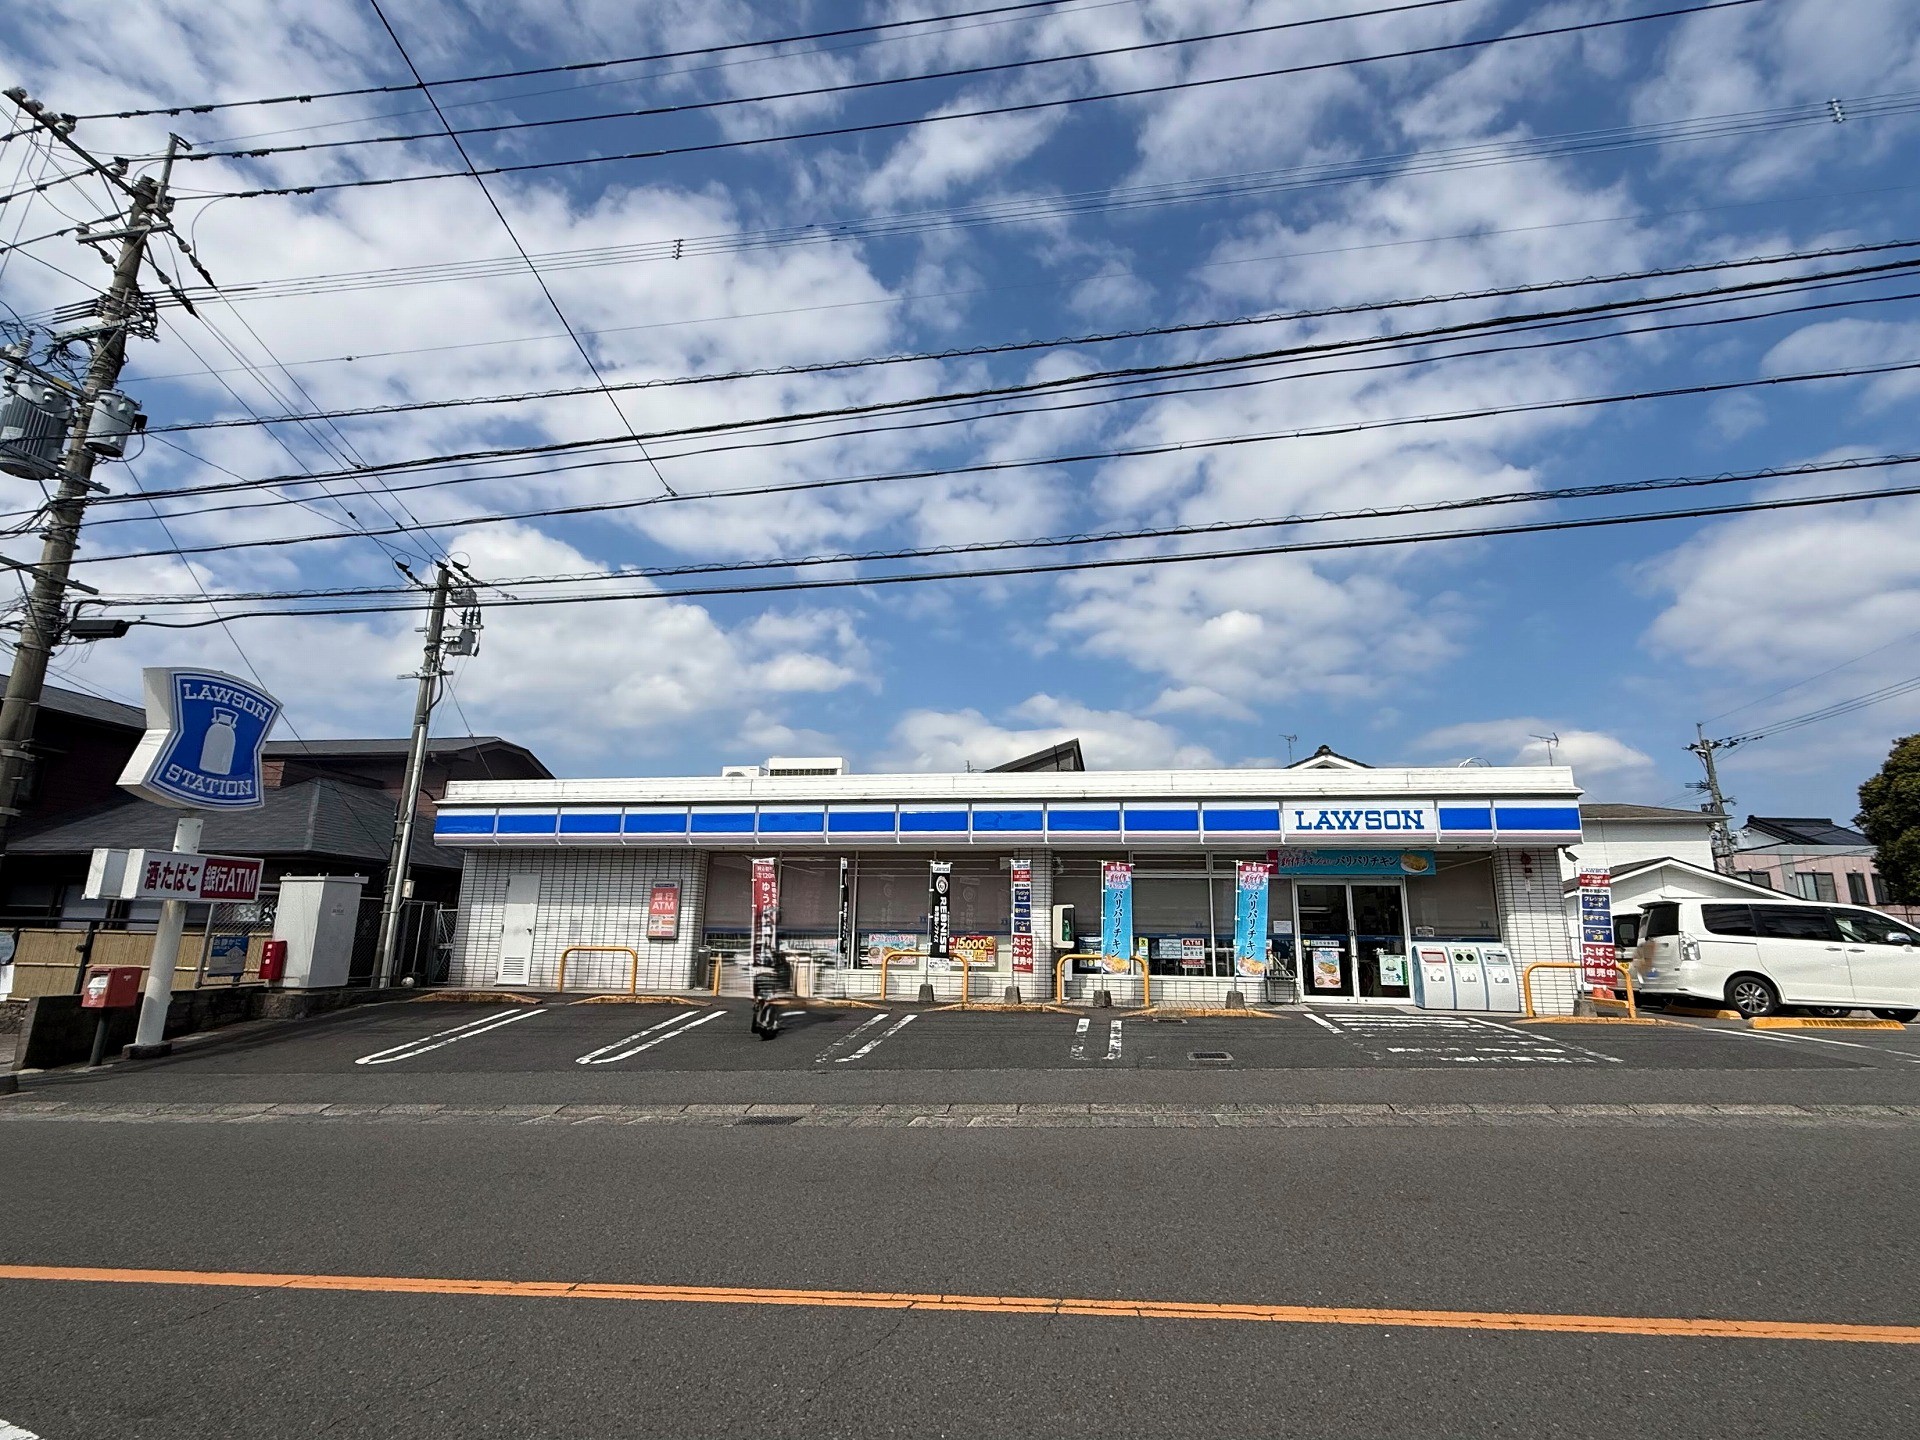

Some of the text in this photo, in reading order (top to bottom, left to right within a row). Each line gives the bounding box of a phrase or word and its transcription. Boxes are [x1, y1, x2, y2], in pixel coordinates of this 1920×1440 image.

[183, 683, 270, 722] LAWSON
[165, 763, 252, 796] STATION
[1295, 810, 1425, 830] LAWSON
[145, 860, 199, 892] 酒・たばこ
[203, 865, 257, 893] 銀行ATM
[652, 902, 674, 910] ATM
[940, 897, 948, 953] REBNISE
[1013, 937, 1032, 946] たばこ
[1013, 947, 1032, 955] カートン
[1585, 946, 1614, 957] たばこ
[1585, 956, 1615, 967] カートン
[1586, 966, 1616, 978] 販売中
